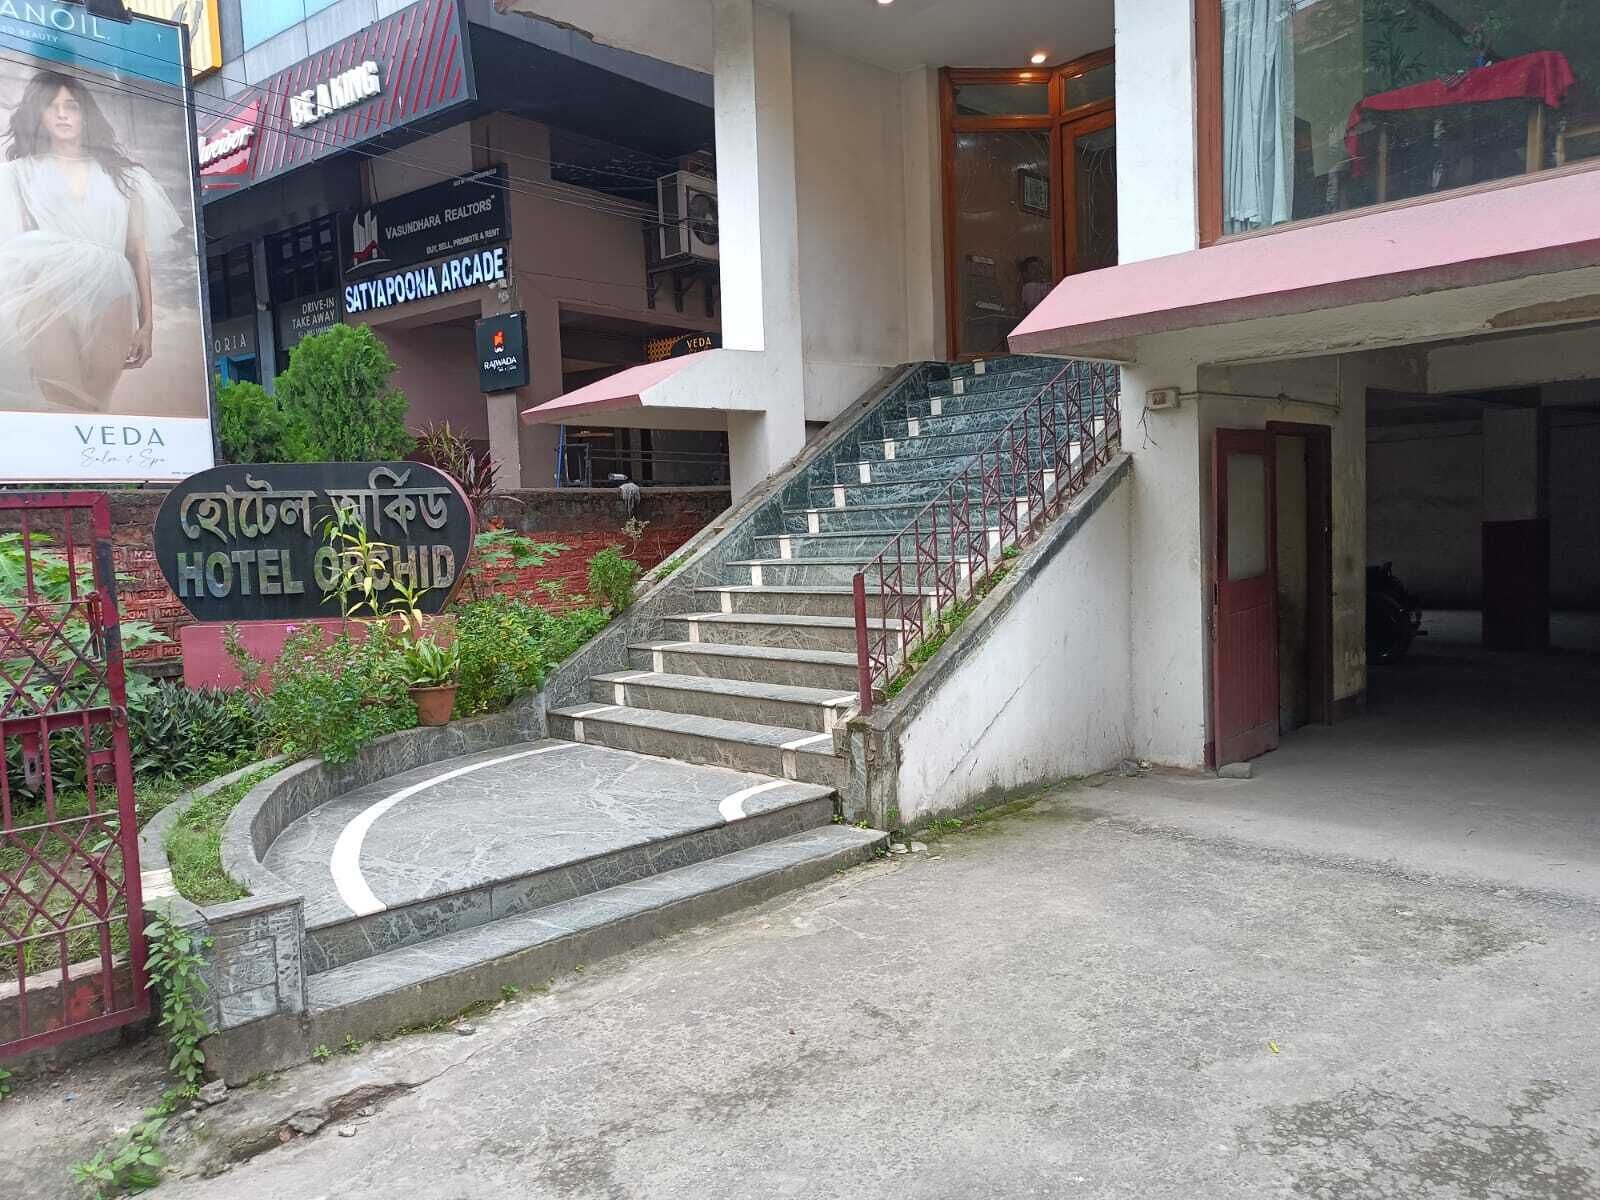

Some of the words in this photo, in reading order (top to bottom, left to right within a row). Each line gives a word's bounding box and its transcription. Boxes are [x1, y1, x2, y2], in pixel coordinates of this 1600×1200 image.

[385, 214, 441, 240] VASUNDHARA
[485, 227, 500, 238] RENT
[345, 267, 438, 313] SATYAPOONA
[441, 248, 504, 293] ARCADE
[302, 297, 335, 315] DRIVE-IN
[291, 316, 311, 329] TAKE
[311, 309, 335, 325] AWAY
[686, 336, 712, 349] VEDA
[484, 355, 517, 370] RAJWADA
[75, 424, 165, 447] VEDA
[180, 472, 318, 544] হোটেল
[324, 466, 453, 537] অর্কিড
[176, 549, 305, 598] HOTEL
[313, 544, 456, 593] ORCHID
